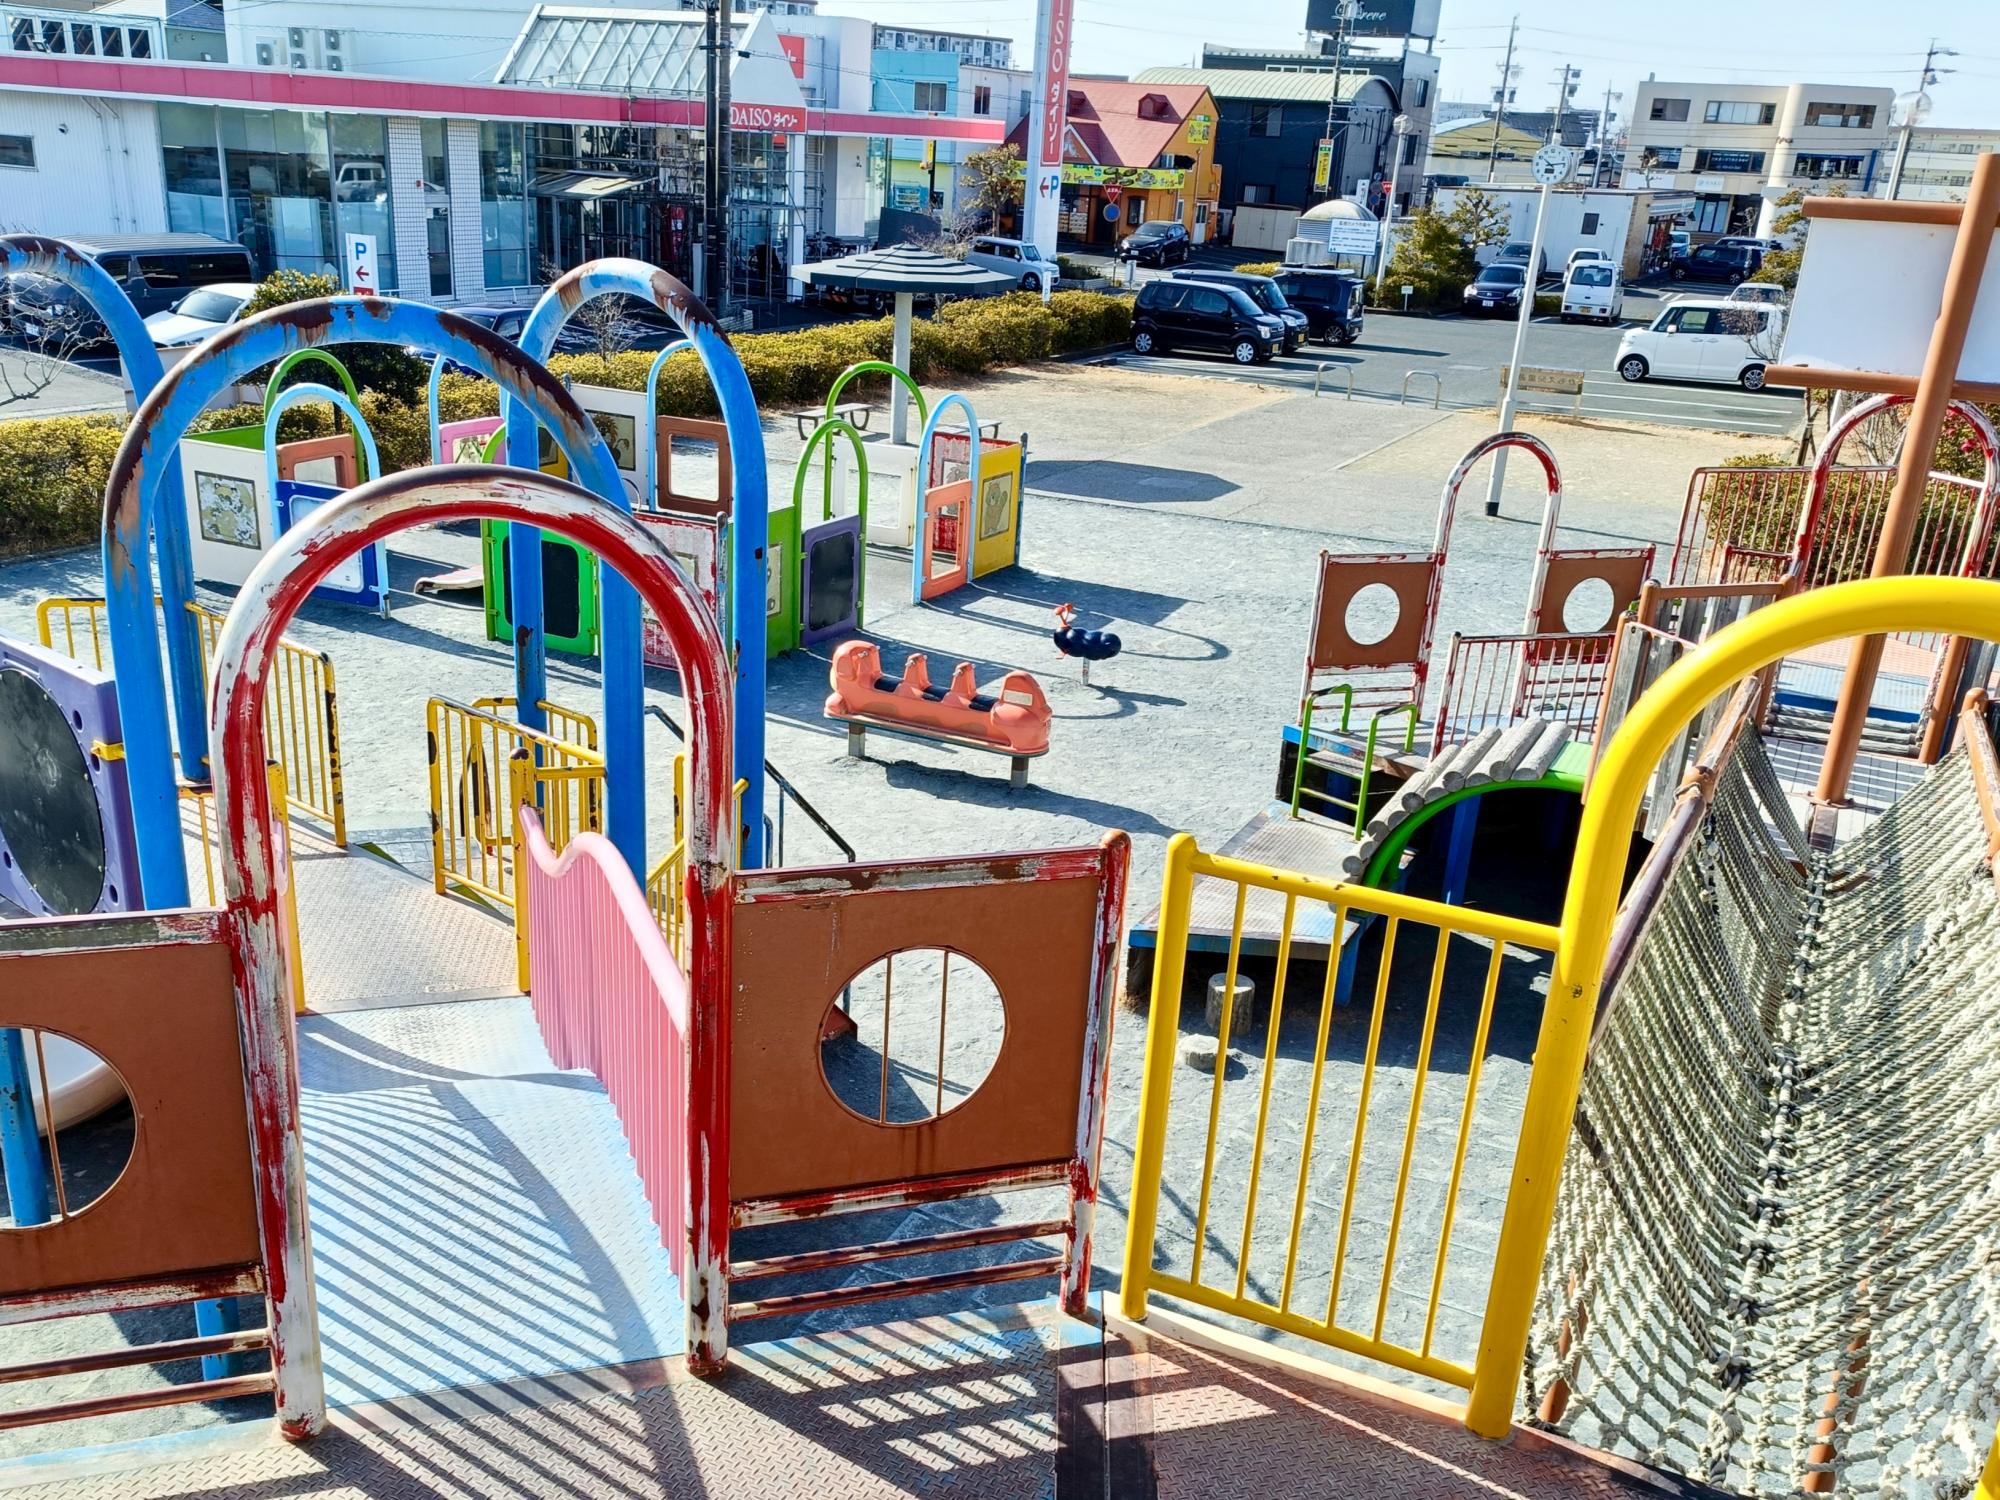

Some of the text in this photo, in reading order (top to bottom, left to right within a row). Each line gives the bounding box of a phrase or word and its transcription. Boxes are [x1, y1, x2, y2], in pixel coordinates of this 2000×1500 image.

[731, 106, 798, 127] DAISO ダイソー
[1049, 81, 1060, 155] ダイソー
[1051, 175, 1059, 199] P
[355, 242, 367, 260] P
